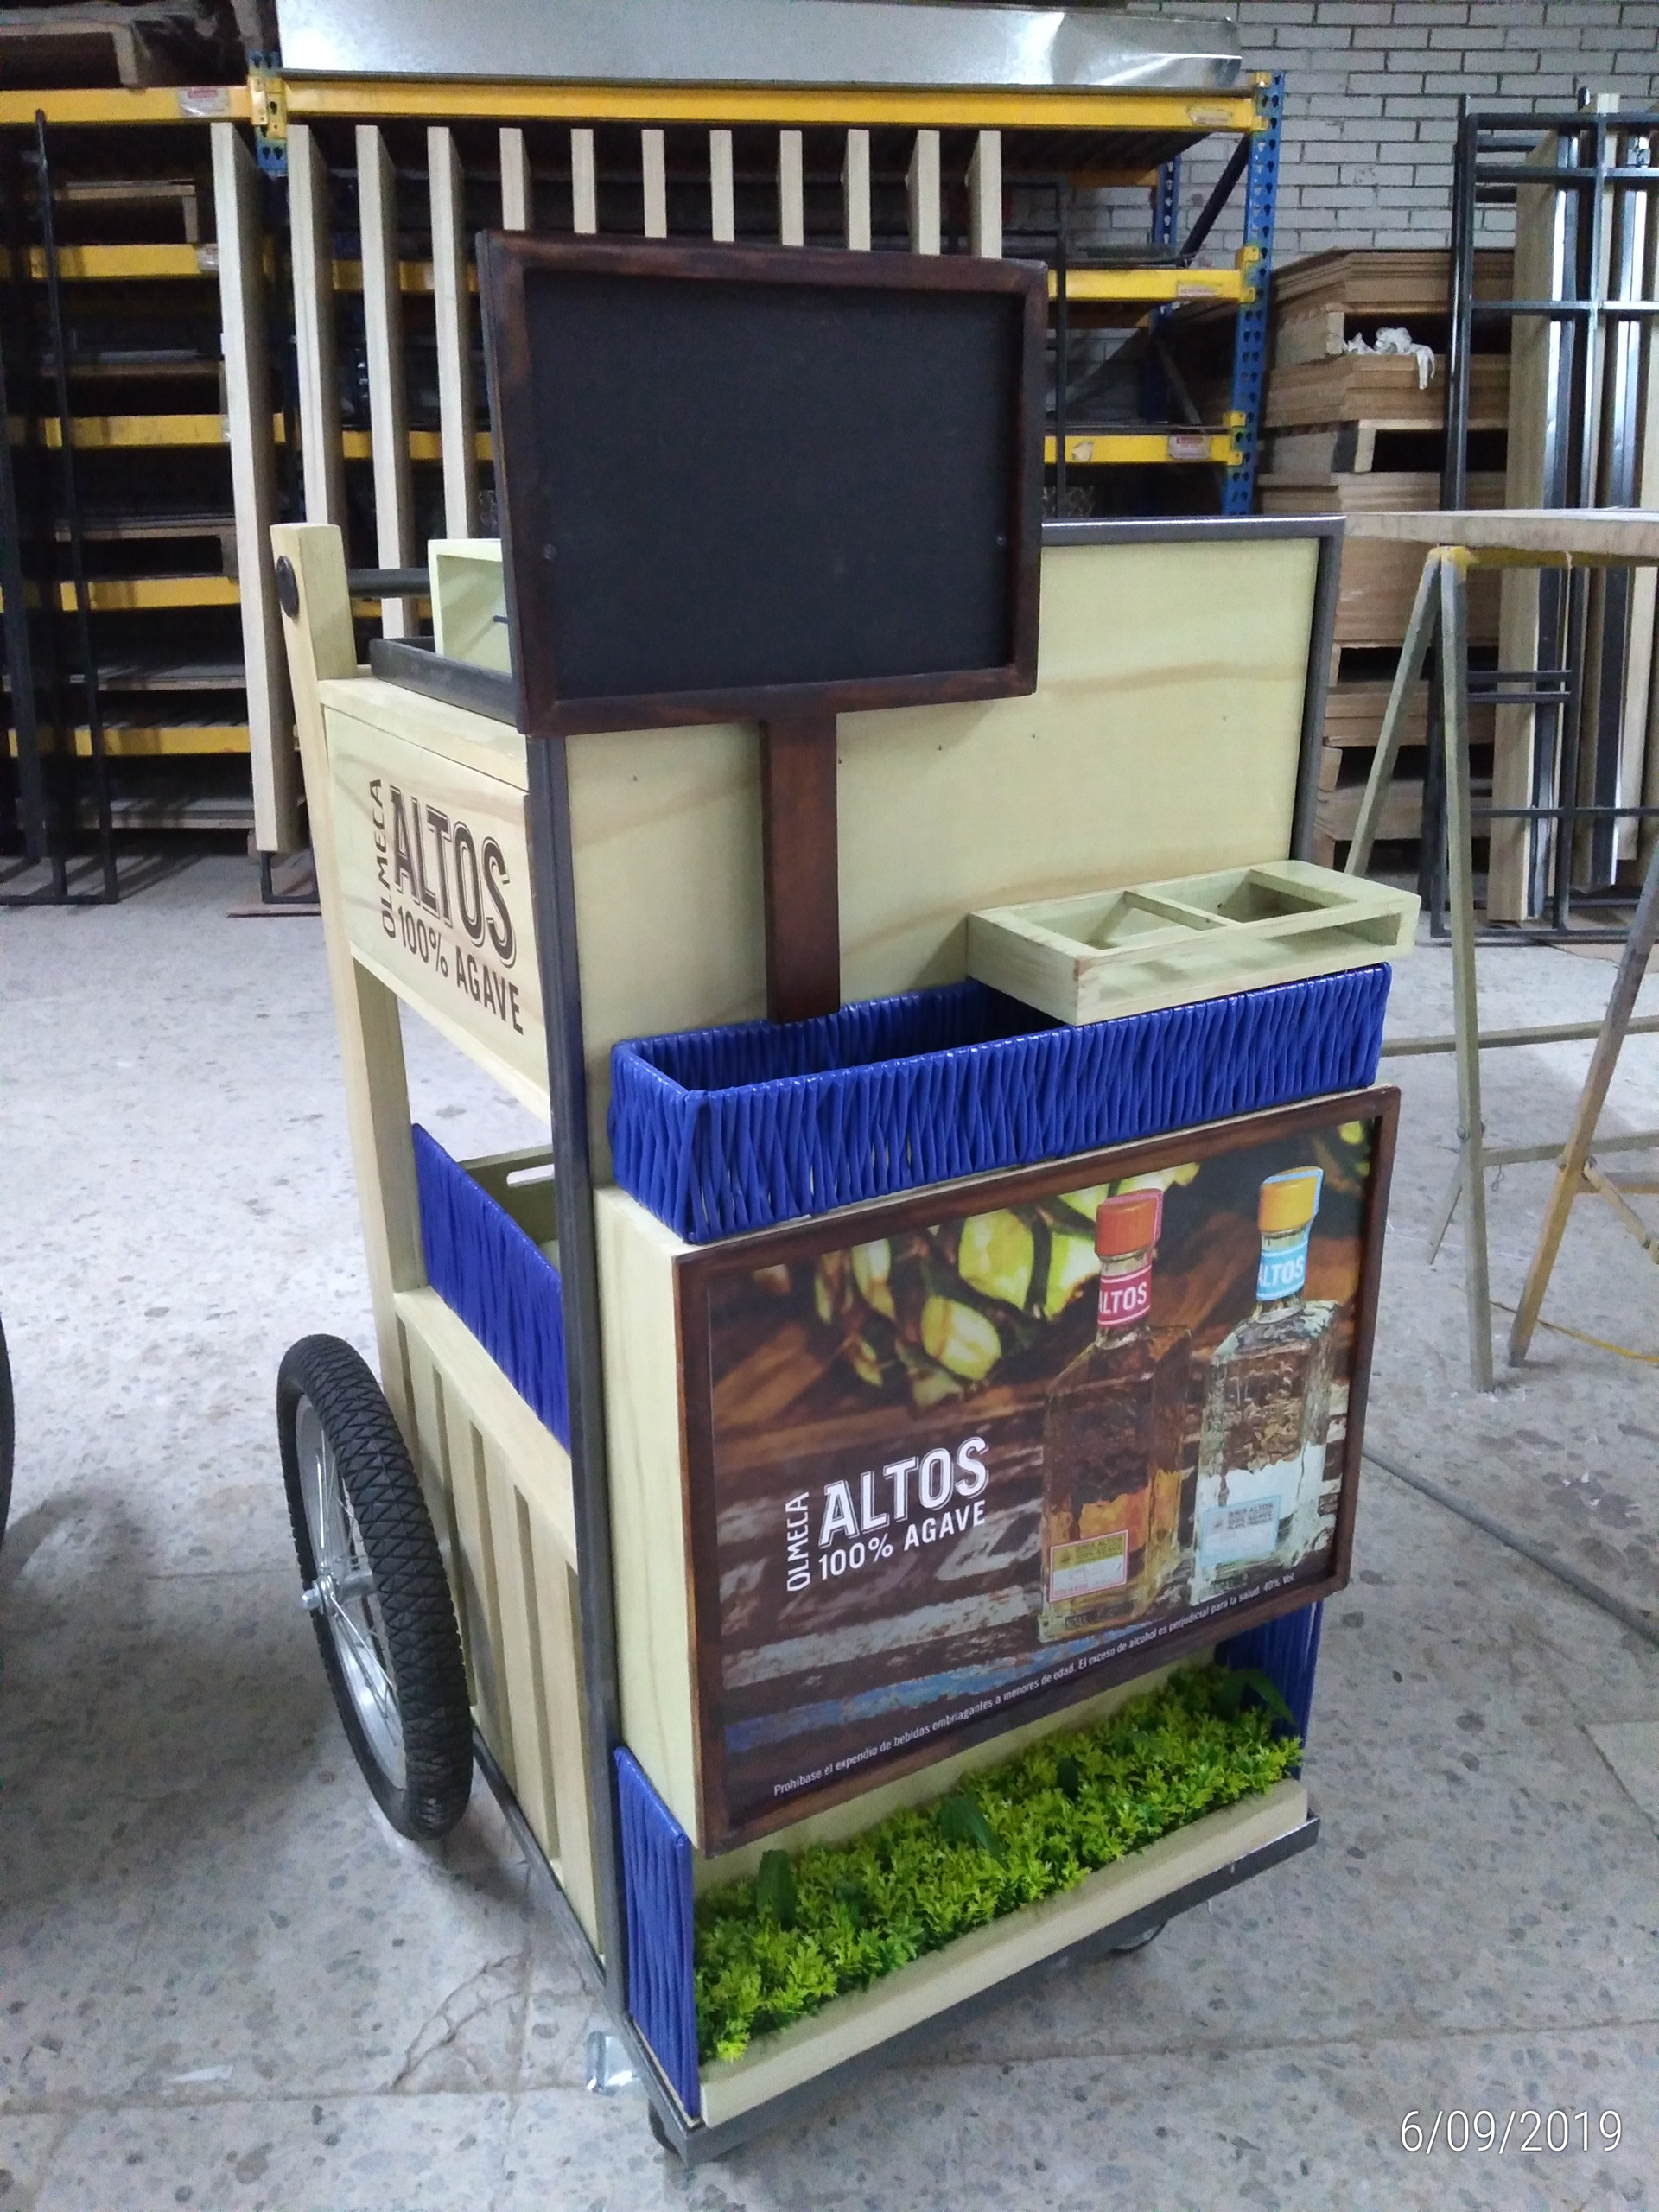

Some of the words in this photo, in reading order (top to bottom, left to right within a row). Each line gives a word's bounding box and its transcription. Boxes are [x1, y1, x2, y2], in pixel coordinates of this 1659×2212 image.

[369, 779, 397, 939] OLMECA
[390, 784, 518, 969] ALTOS
[398, 906, 449, 978] 100%
[455, 944, 524, 1036] AGAVE
[785, 1491, 811, 1592] OLMECA
[817, 1435, 990, 1549] ALTOS
[817, 1532, 894, 1580] 100%
[903, 1499, 986, 1552] AGAVE
[824, 1763, 834, 1776] el
[835, 1746, 878, 1770] expendio
[880, 1740, 892, 1753] de
[893, 1725, 931, 1747] bebidas
[931, 1699, 993, 1731] embriagantes
[995, 1695, 1002, 1705] a
[1003, 1680, 1039, 1700] menores
[1040, 1673, 1052, 1685] de
[1078, 1658, 1087, 1670] El
[1089, 1647, 1116, 1666] exceso
[1116, 1643, 1128, 1654] de
[1128, 1628, 1157, 1649] alcohol
[1158, 1626, 1167, 1637] es
[1168, 1607, 1210, 1633] perjudicial
[1211, 1600, 1229, 1615] para
[1230, 1596, 1237, 1606] la
